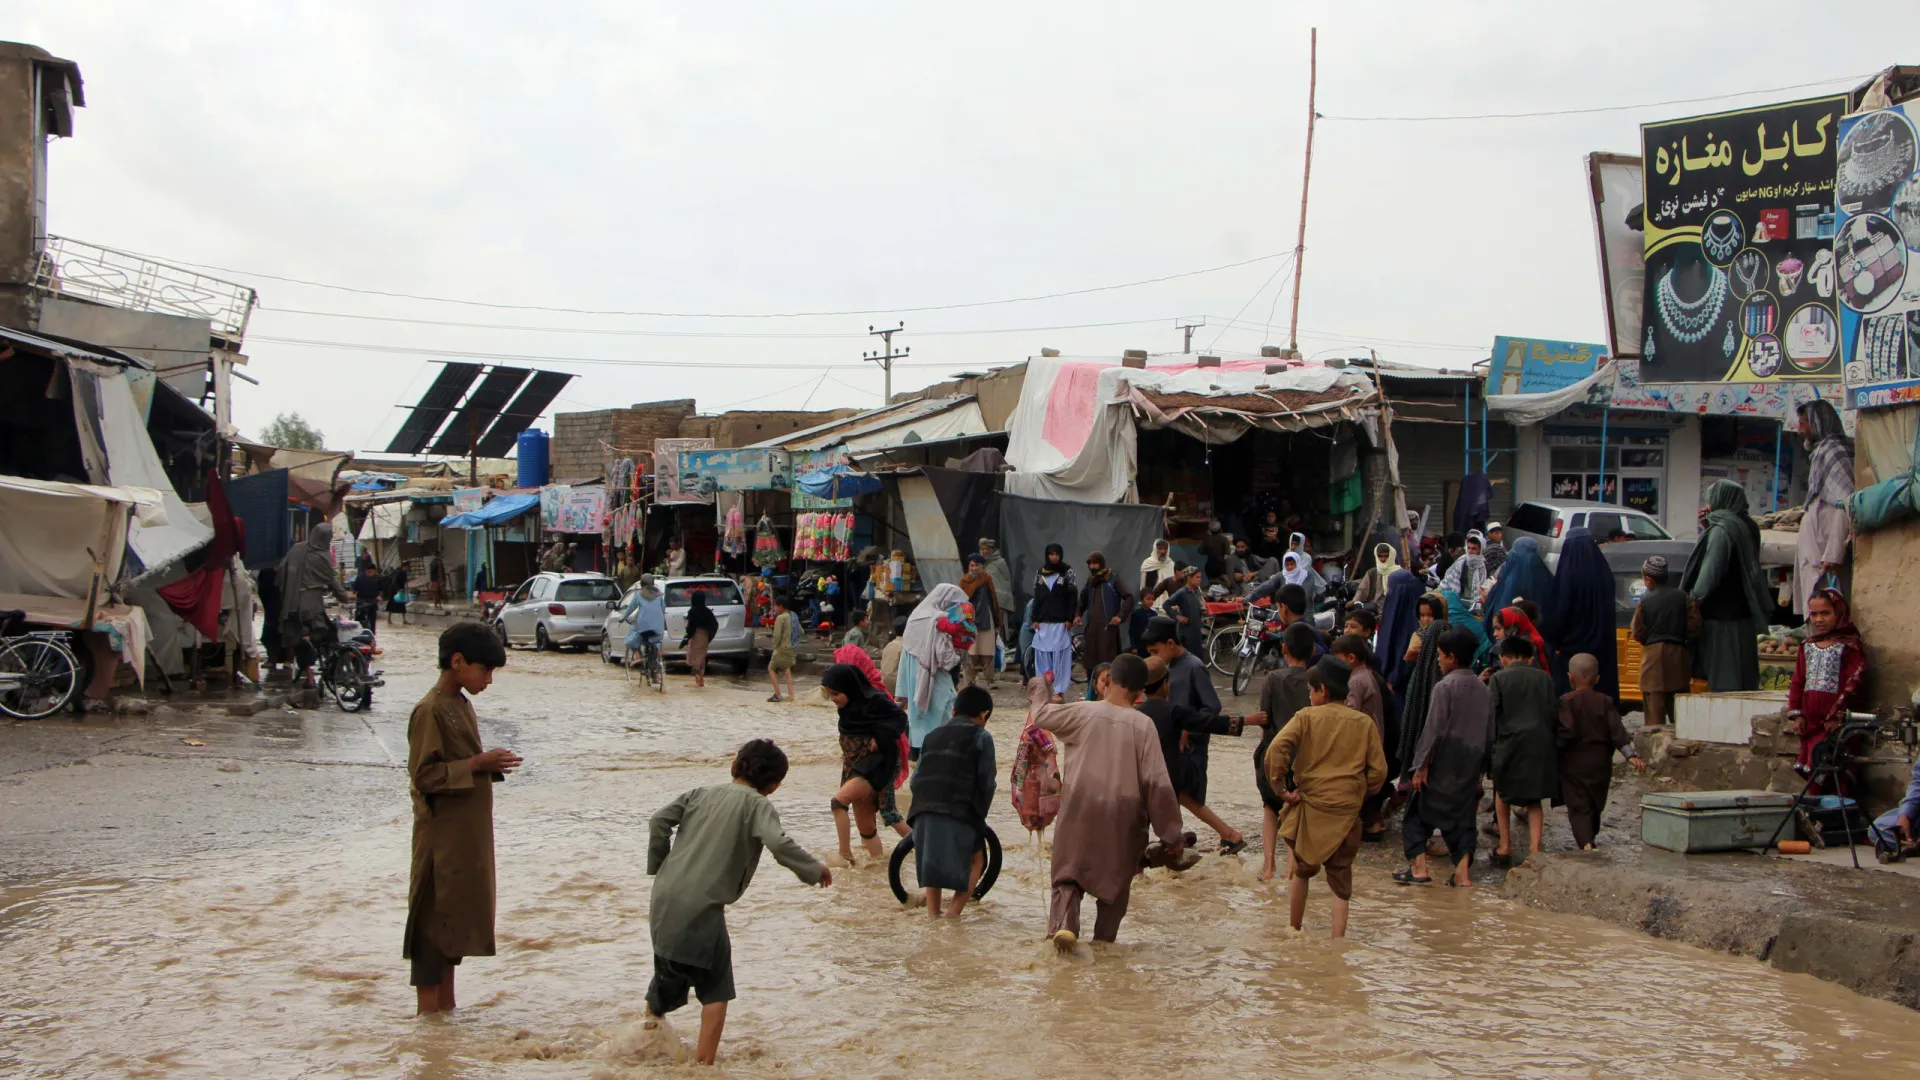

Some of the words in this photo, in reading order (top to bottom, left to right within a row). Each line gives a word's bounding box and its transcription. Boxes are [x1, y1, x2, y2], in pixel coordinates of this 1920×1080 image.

[1742, 112, 1832, 176] کابل
[1656, 131, 1732, 186] مغازه
[1759, 186, 1773, 199] NG
[1774, 184, 1782, 198] او
[1783, 181, 1800, 197] کریم
